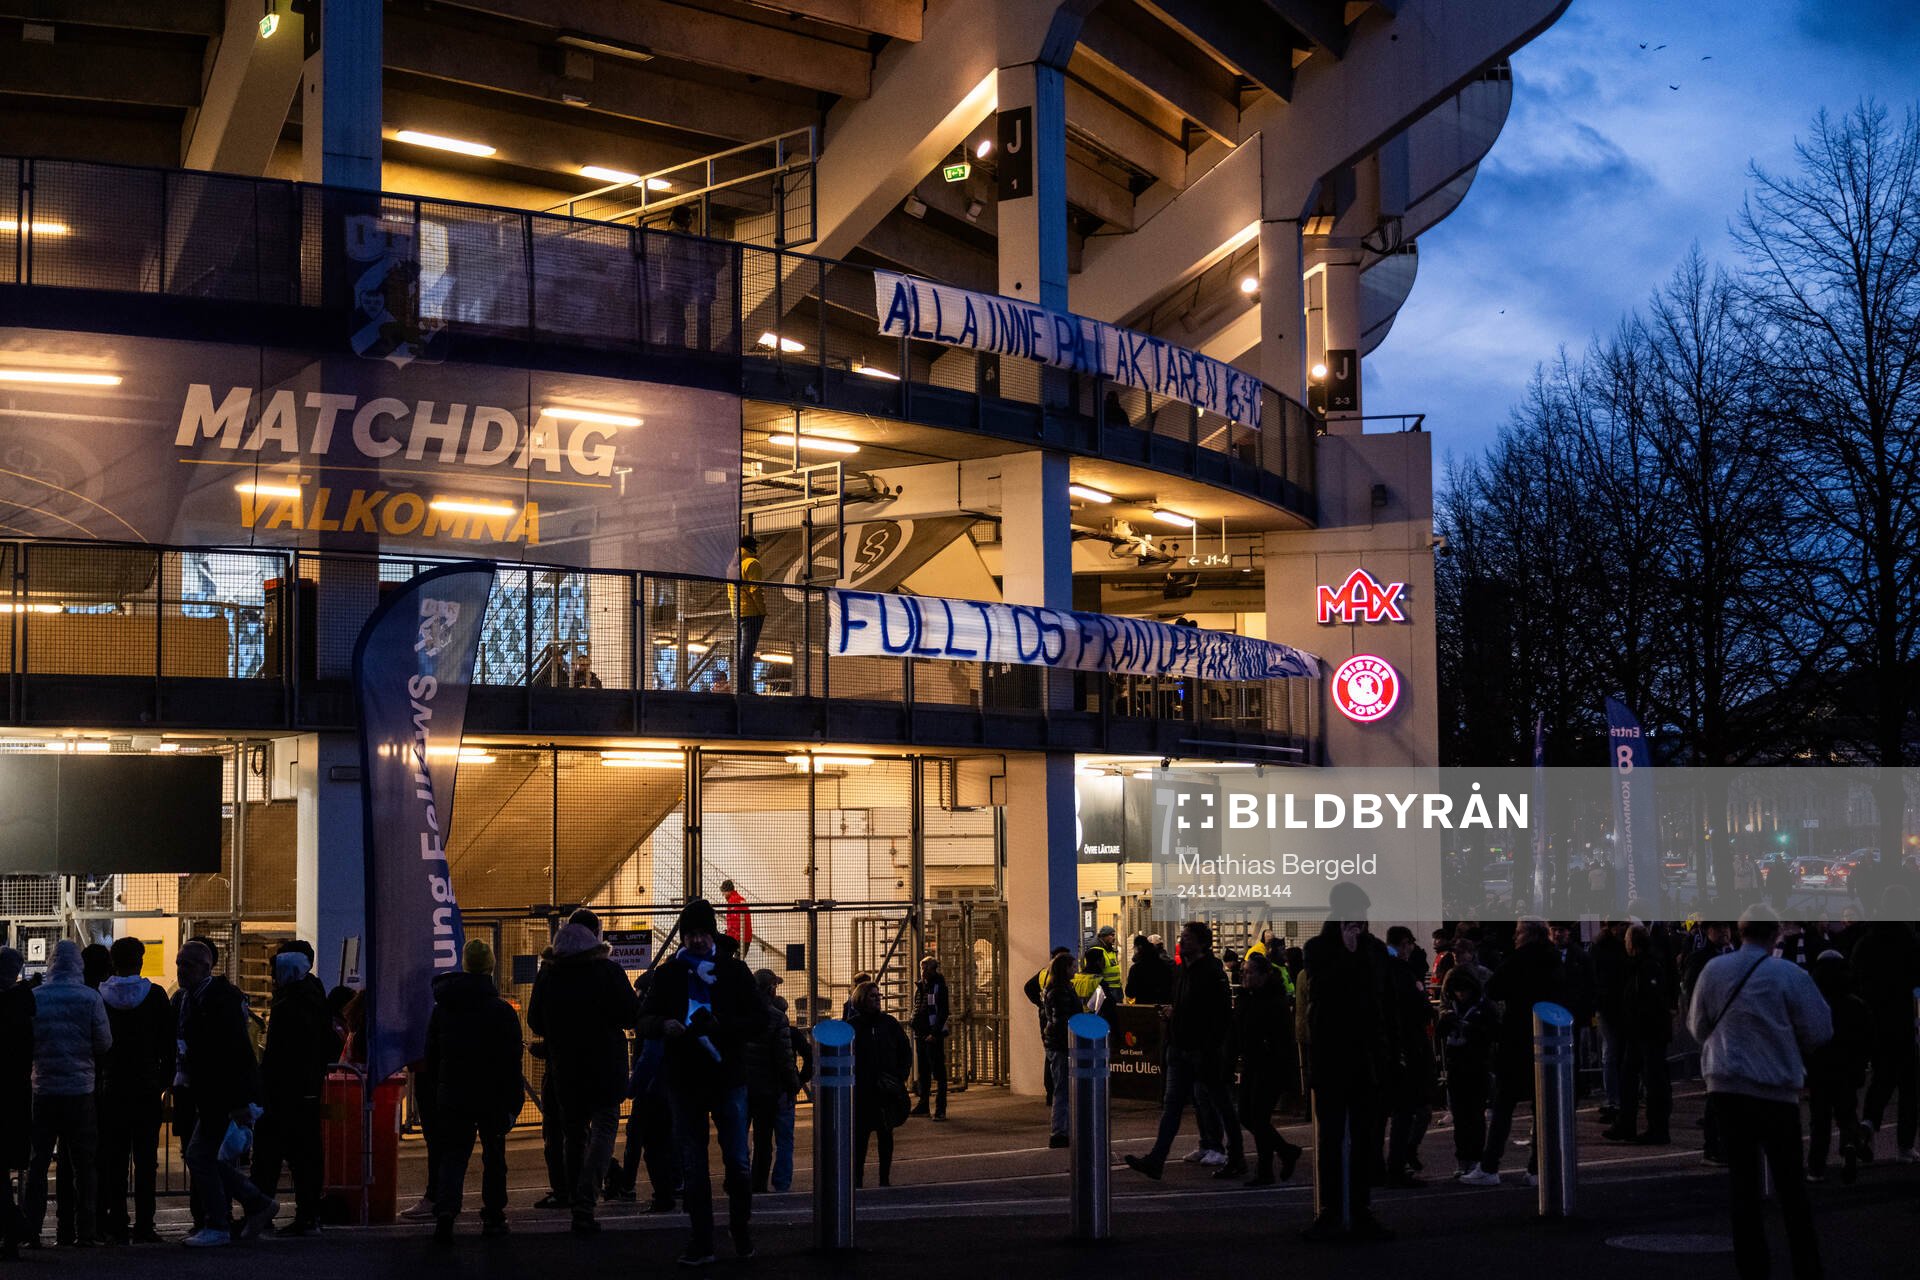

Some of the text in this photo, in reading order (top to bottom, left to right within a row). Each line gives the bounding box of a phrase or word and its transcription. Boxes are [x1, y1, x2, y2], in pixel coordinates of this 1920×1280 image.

[1006, 119, 1022, 154] J
[1011, 178, 1018, 190] 1
[883, 281, 979, 349] ALLA
[987, 300, 1049, 362] INNE
[1094, 322, 1218, 410] LÄKTAREN
[1335, 356, 1349, 380] J
[175, 383, 619, 478] MATCHDAG
[239, 474, 540, 545] VÄLKOMNA
[1203, 554, 1230, 566] J1-4
[1316, 568, 1405, 624] MAX
[838, 591, 993, 662] FULLT
[1340, 660, 1391, 683] MISTER
[1346, 699, 1387, 716] YORK
[407, 673, 459, 973] ung Fellws
[1155, 788, 1175, 855] 7
[1110, 1060, 1161, 1074] amla Ullev
